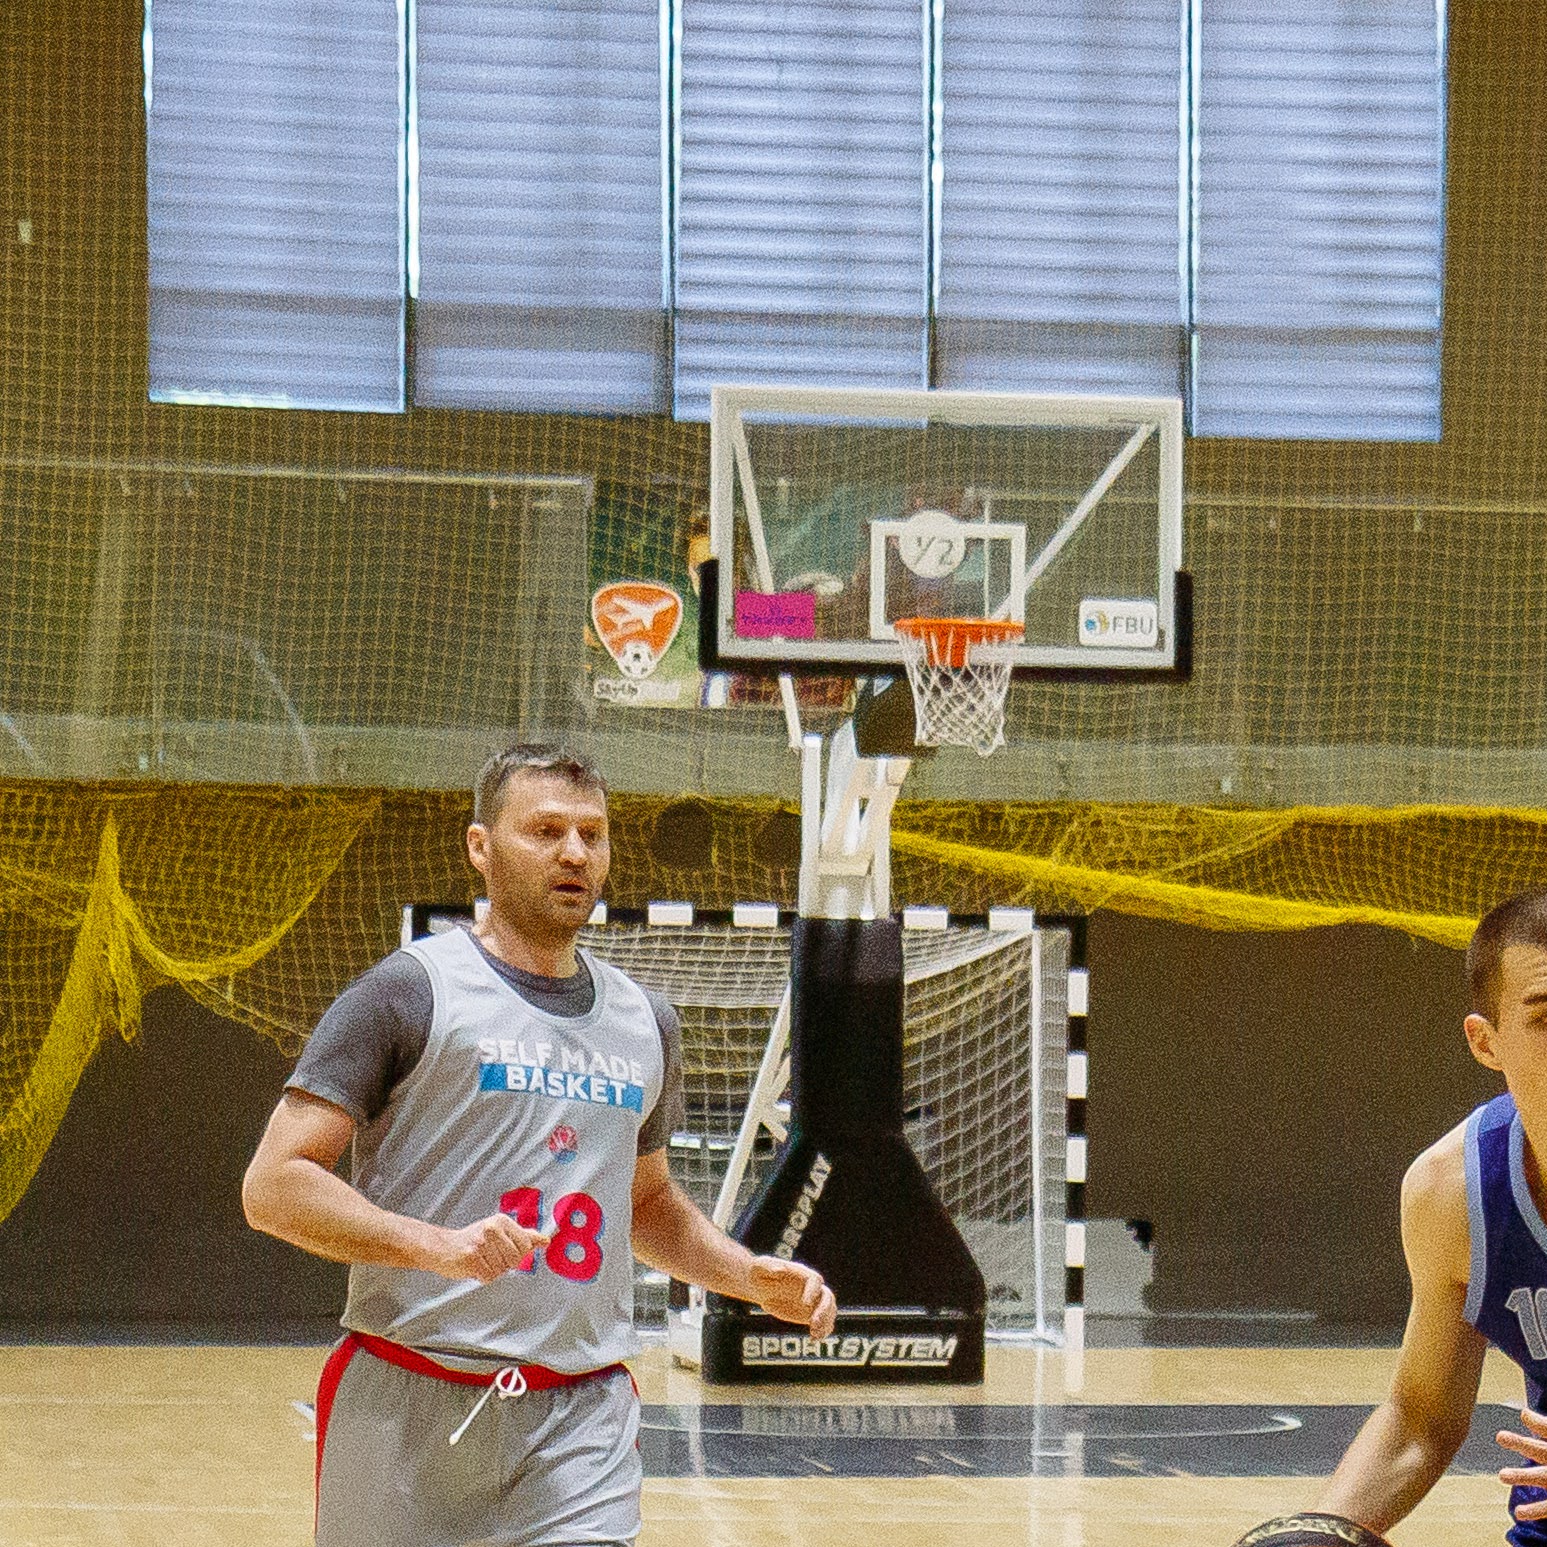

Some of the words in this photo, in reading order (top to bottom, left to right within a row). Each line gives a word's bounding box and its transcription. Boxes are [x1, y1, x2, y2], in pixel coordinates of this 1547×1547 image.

[1112, 615, 1153, 635] FBU
[478, 1038, 552, 1069] SELF
[560, 1046, 645, 1087] MADE
[505, 1064, 627, 1106] BASKET
[500, 1186, 605, 1285] 18
[742, 1335, 959, 1366] SPORTSYSTEM
